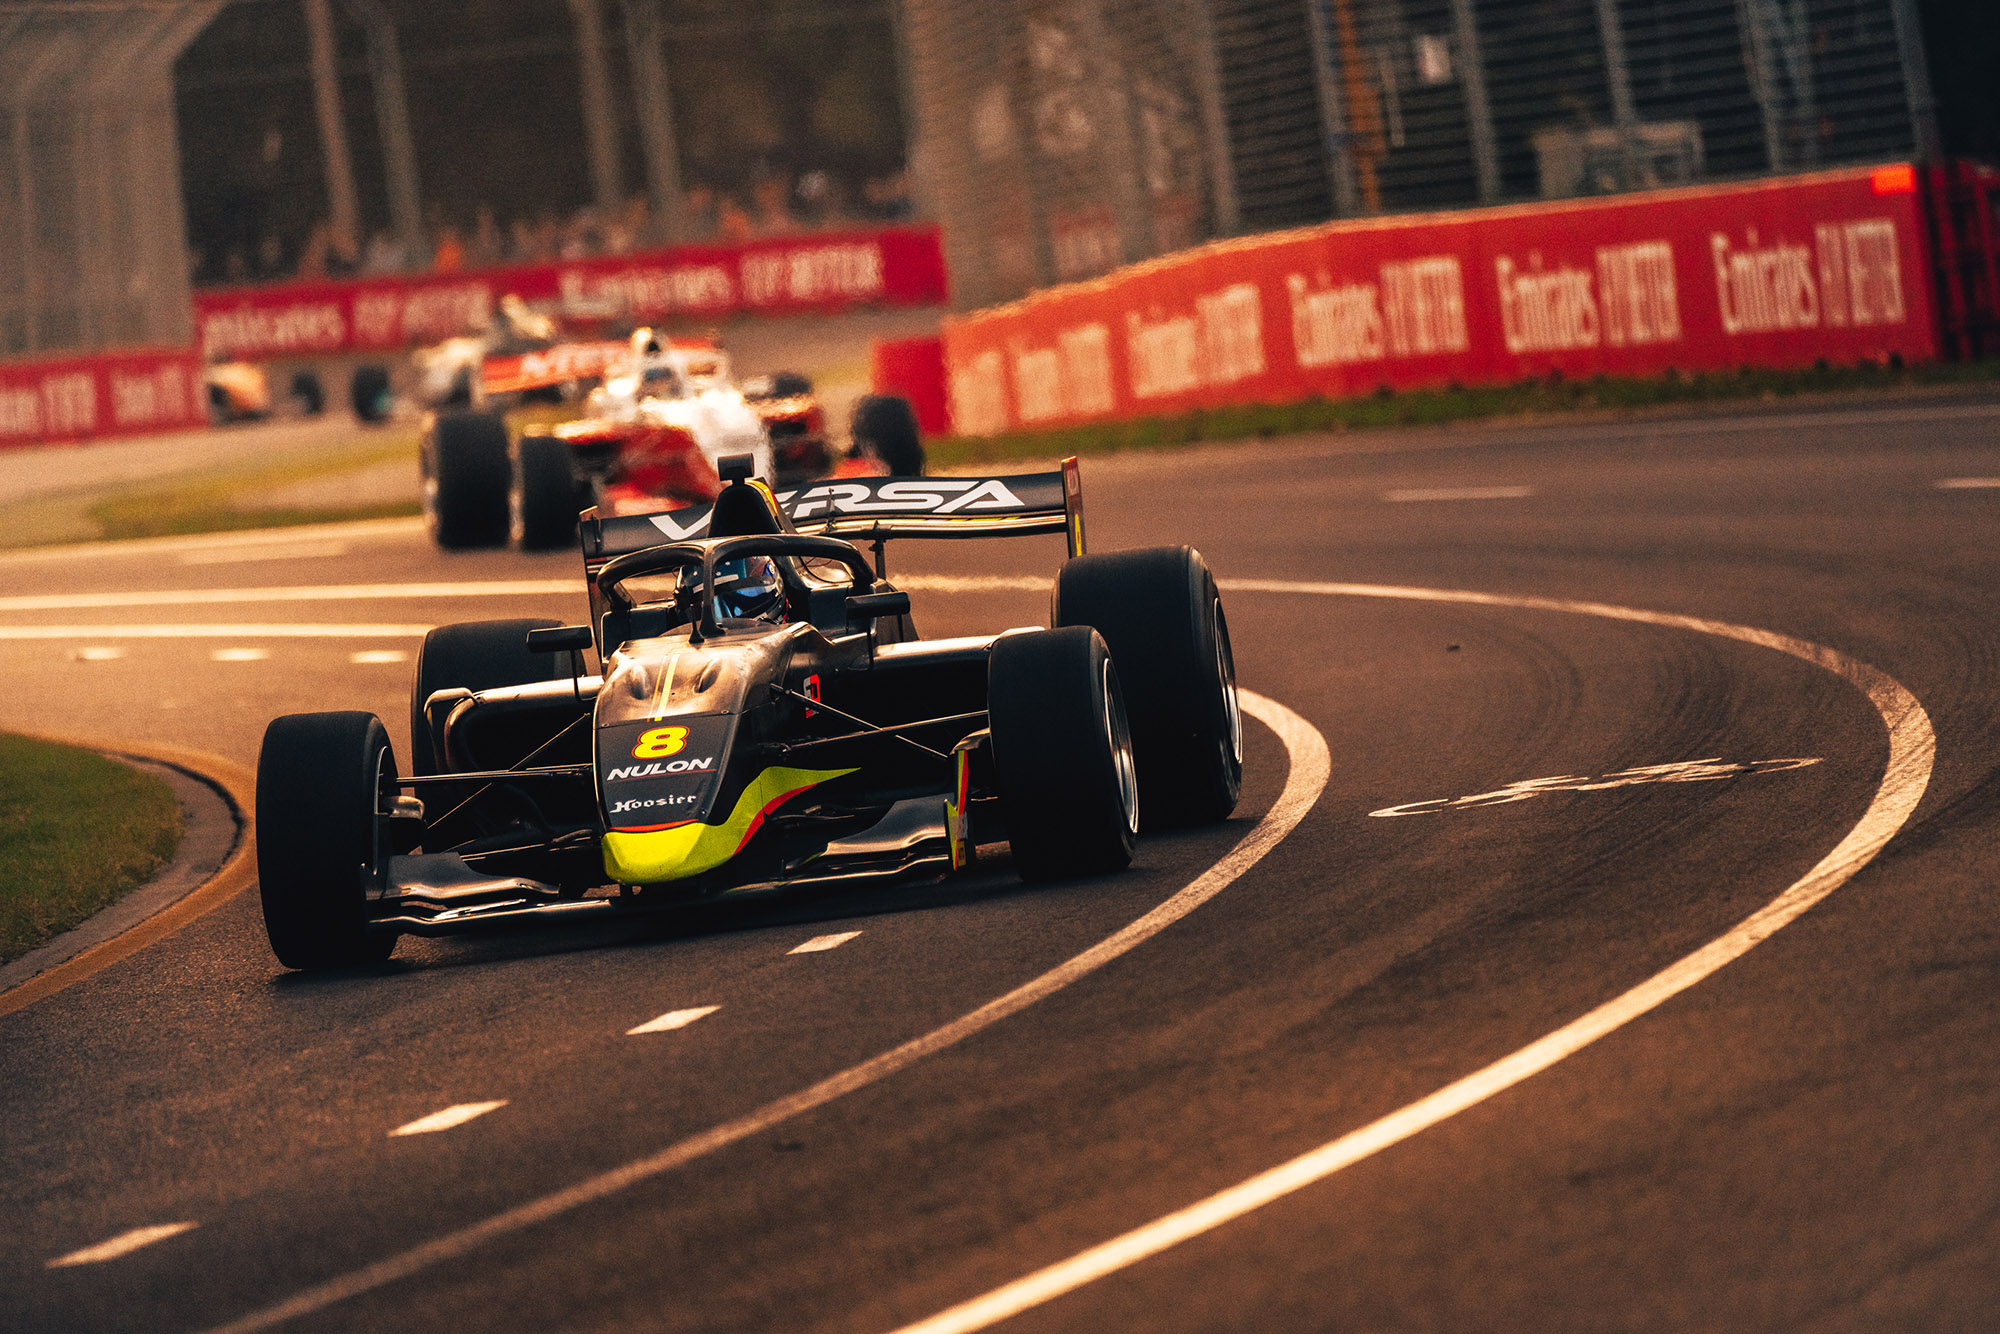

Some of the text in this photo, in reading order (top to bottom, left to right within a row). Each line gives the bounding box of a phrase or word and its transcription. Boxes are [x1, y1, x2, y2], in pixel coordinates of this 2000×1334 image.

[631, 725, 690, 760] 8
[606, 757, 714, 781] NULON
[608, 794, 697, 814] Hoosier
